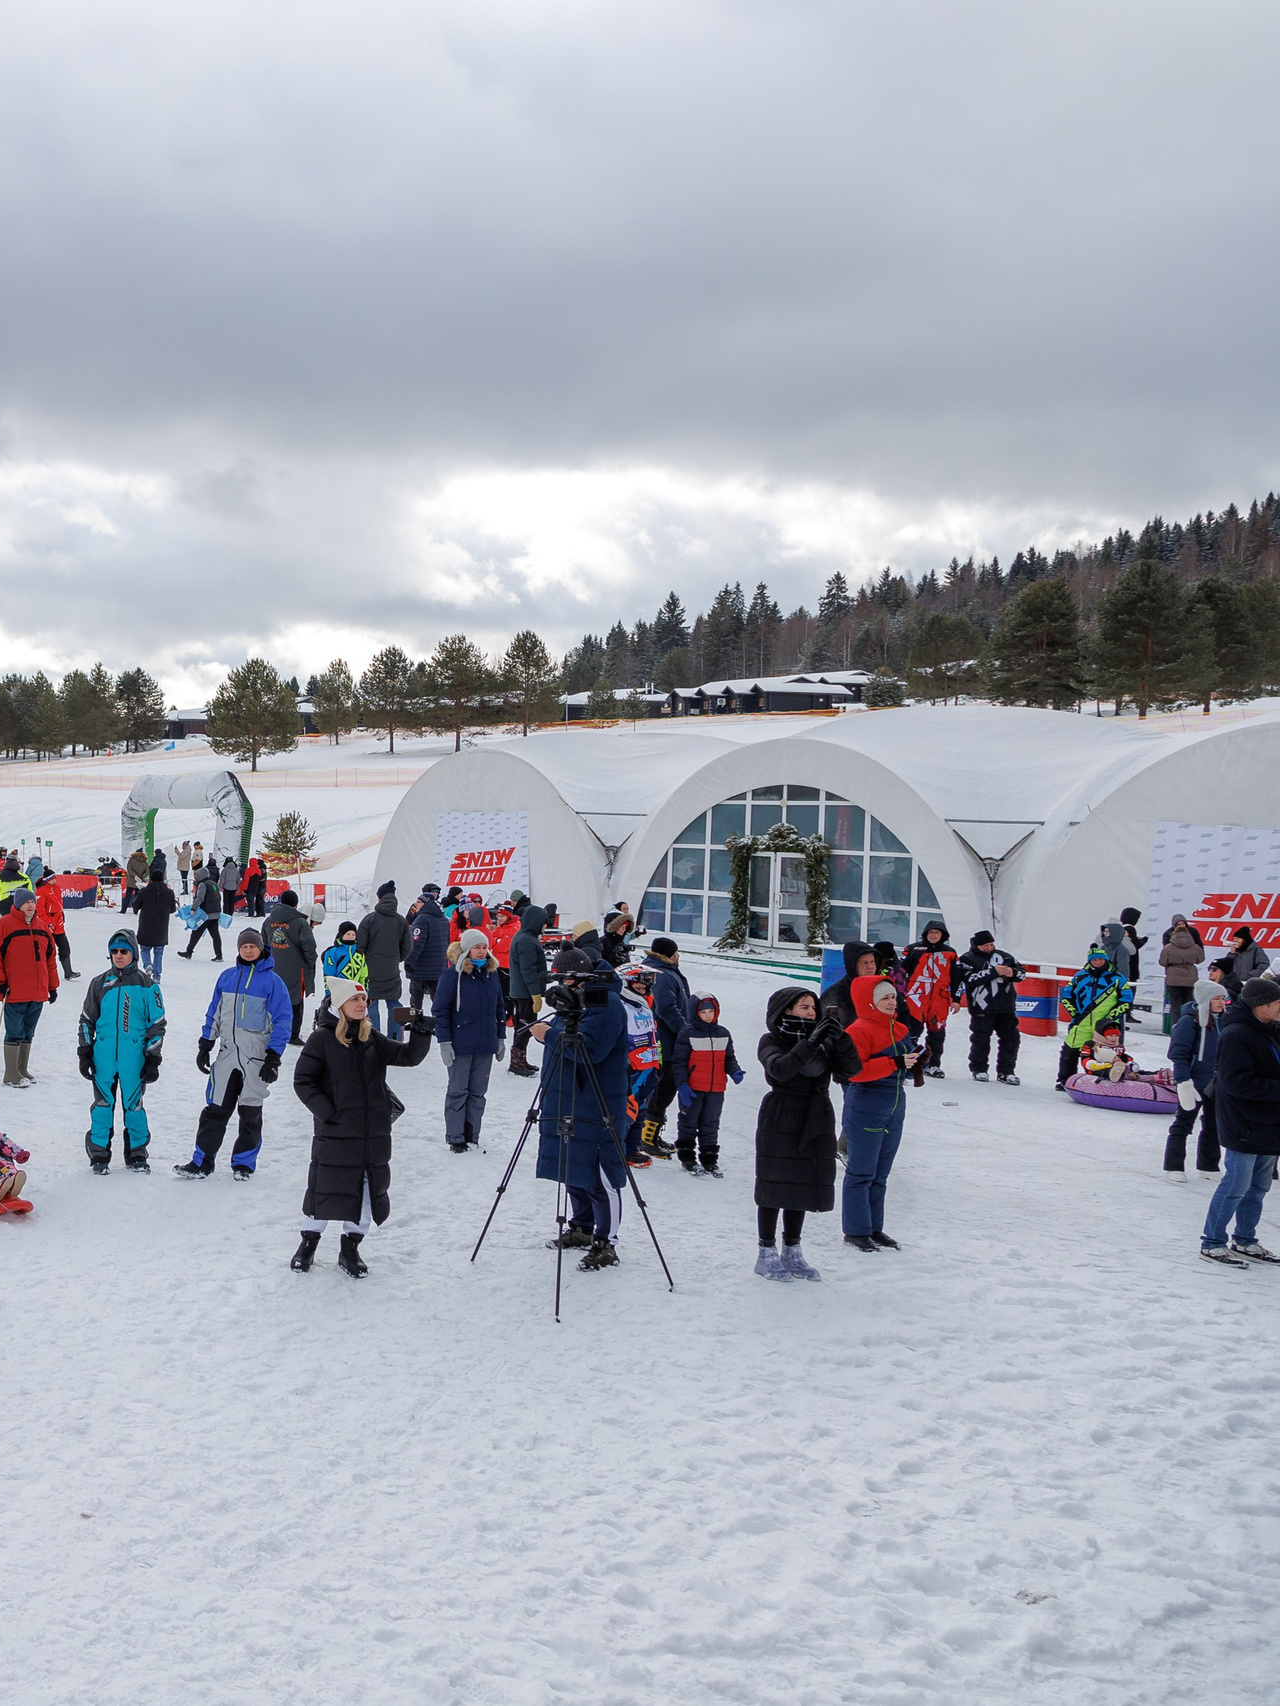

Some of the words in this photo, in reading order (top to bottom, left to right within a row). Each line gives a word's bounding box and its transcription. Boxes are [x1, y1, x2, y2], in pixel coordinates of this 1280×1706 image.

[450, 846, 516, 869] SNOW
[1204, 926, 1280, 944] ПООР
[1095, 992, 1108, 1005] RIDE
